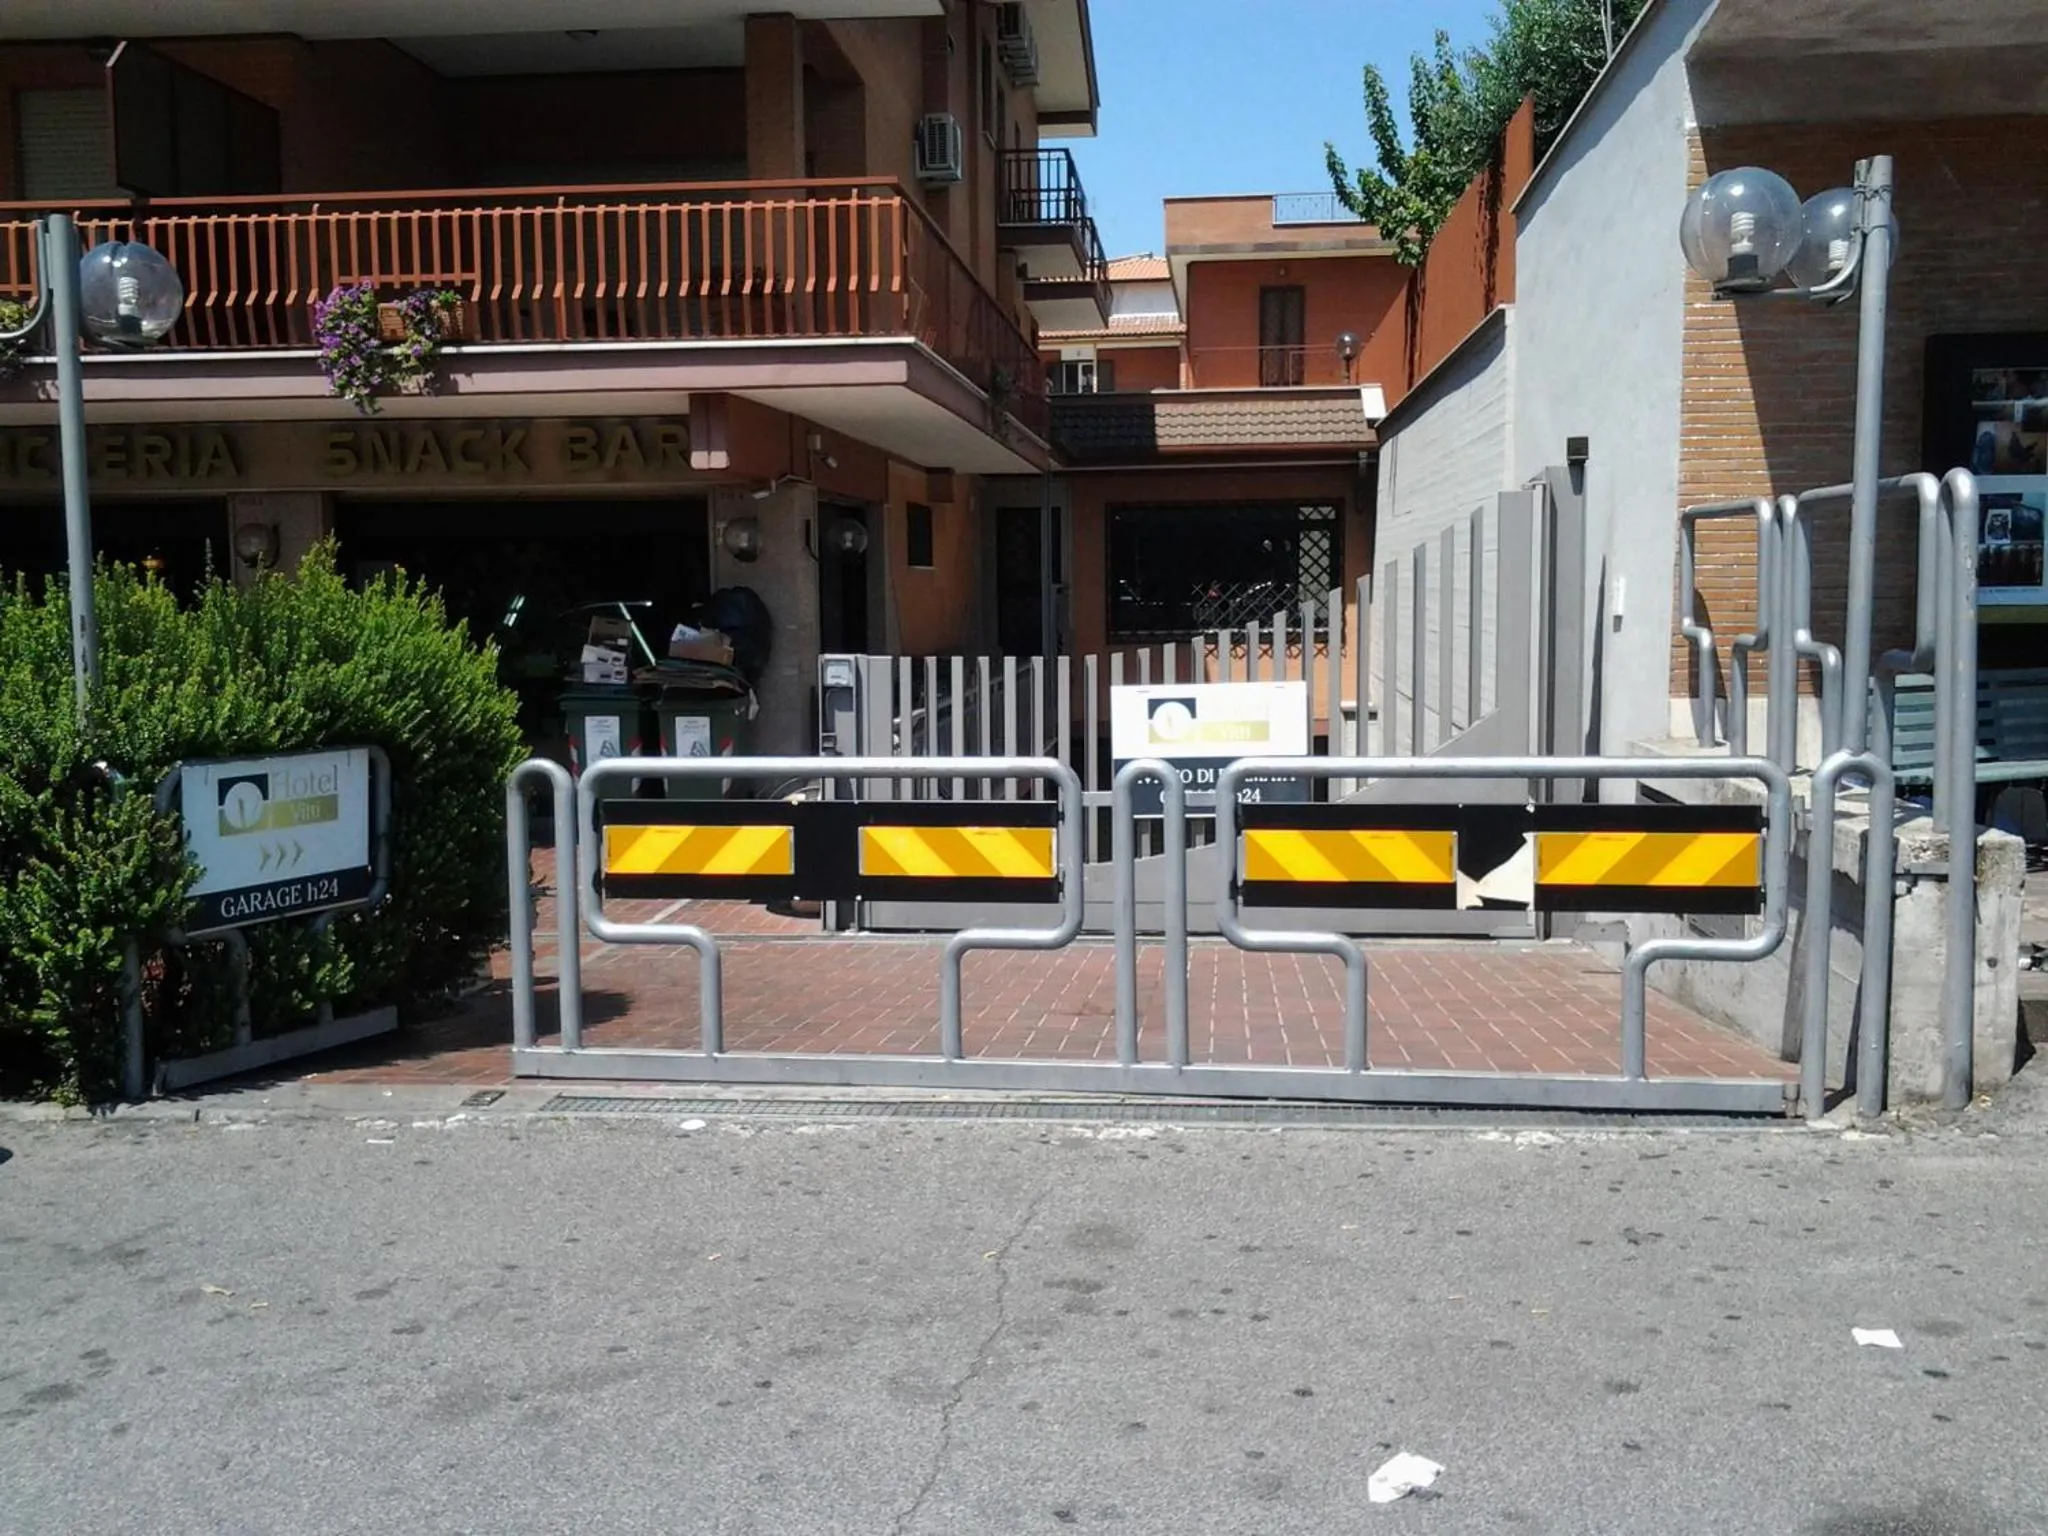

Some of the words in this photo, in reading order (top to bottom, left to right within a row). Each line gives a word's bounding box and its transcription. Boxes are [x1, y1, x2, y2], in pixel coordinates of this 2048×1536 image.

[324, 427, 531, 476] SNACK
[562, 423, 690, 472] BAR
[271, 764, 338, 797] Hotel
[221, 883, 302, 918] GARAGE
[307, 877, 339, 903] h24
